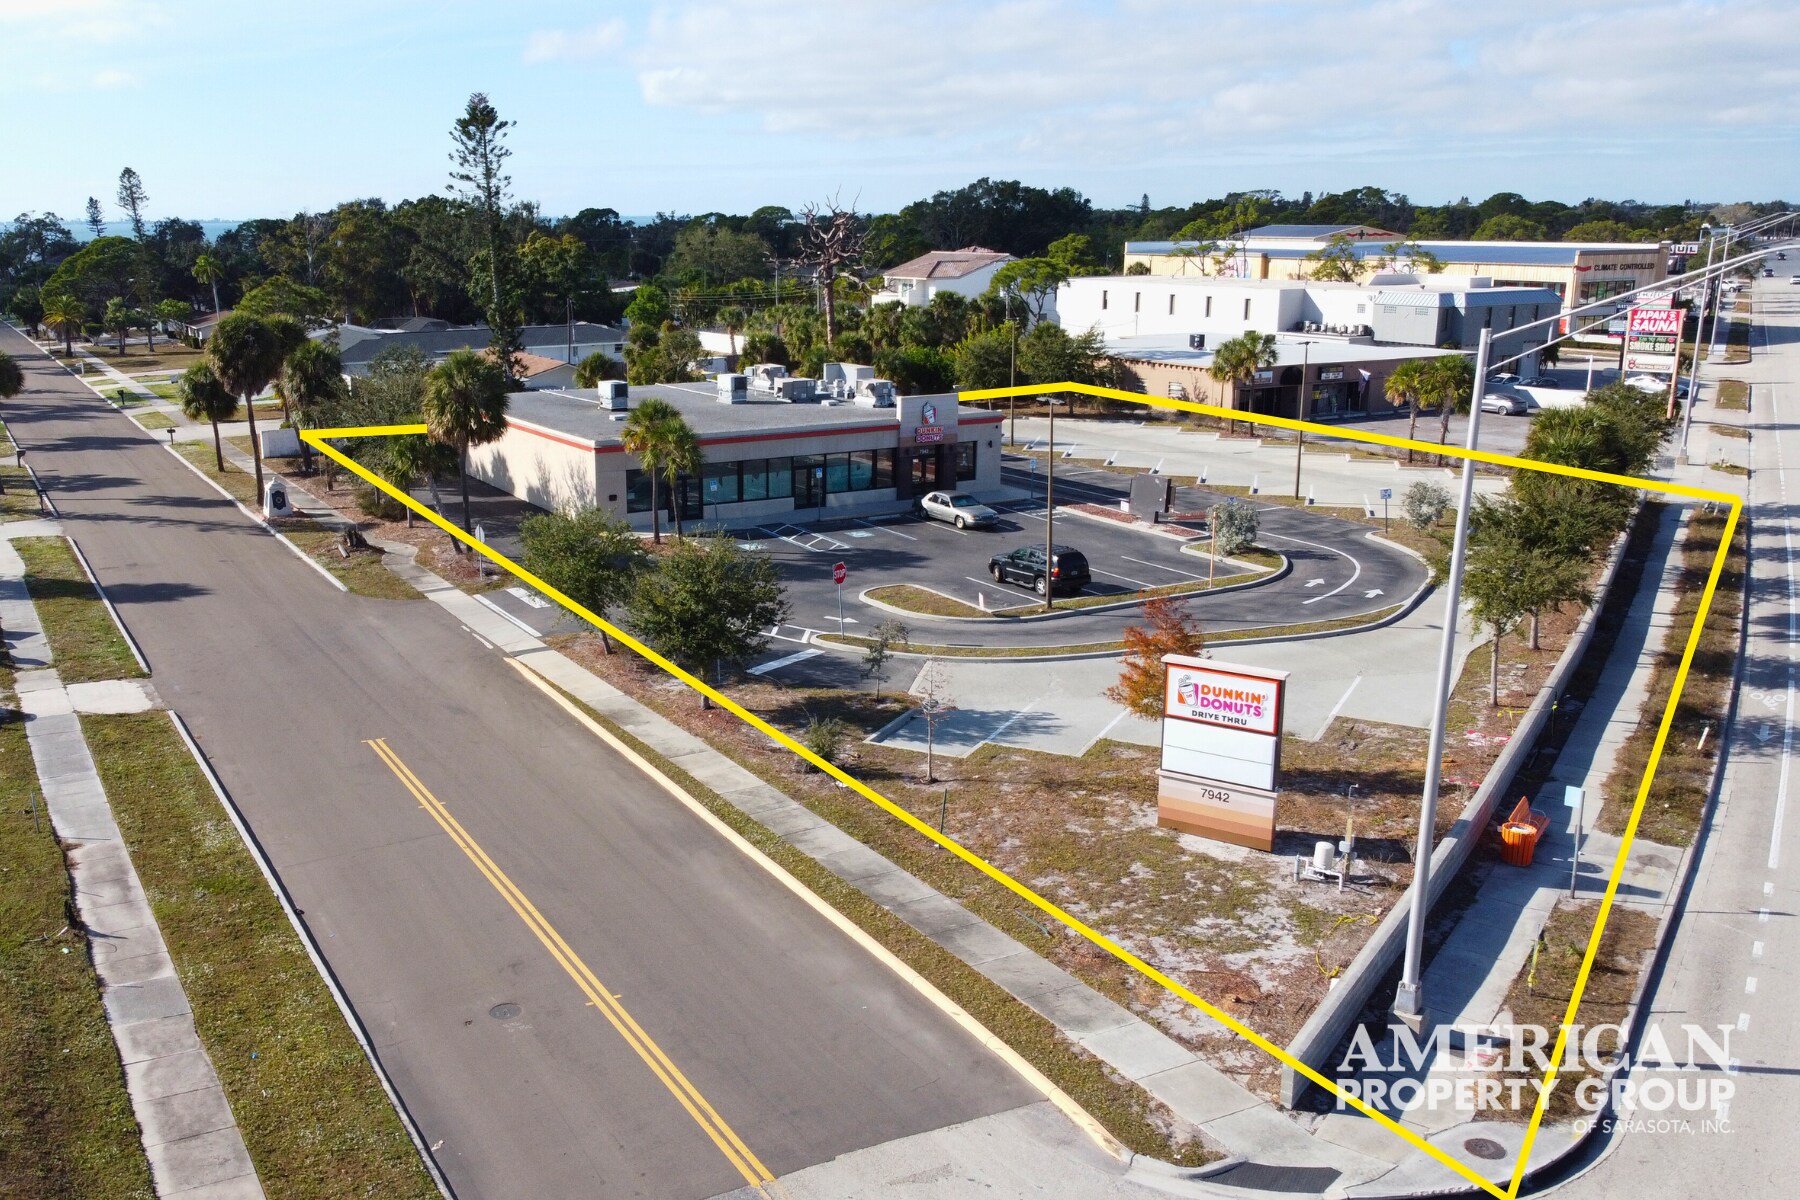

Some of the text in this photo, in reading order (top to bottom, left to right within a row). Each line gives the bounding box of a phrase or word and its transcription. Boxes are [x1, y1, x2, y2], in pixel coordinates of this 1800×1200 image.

[1634, 310, 1668, 319] JAPAN
[1632, 319, 1677, 331] SAUNA
[1629, 341, 1675, 352] SMOKE SHOP
[916, 434, 943, 442] DONUTS
[834, 569, 846, 579] STOP
[1200, 684, 1266, 704] DUNKIN'
[1200, 697, 1262, 717] DONUTS
[1192, 710, 1247, 725] DRIVE THRU
[1201, 788, 1230, 803] 7942
